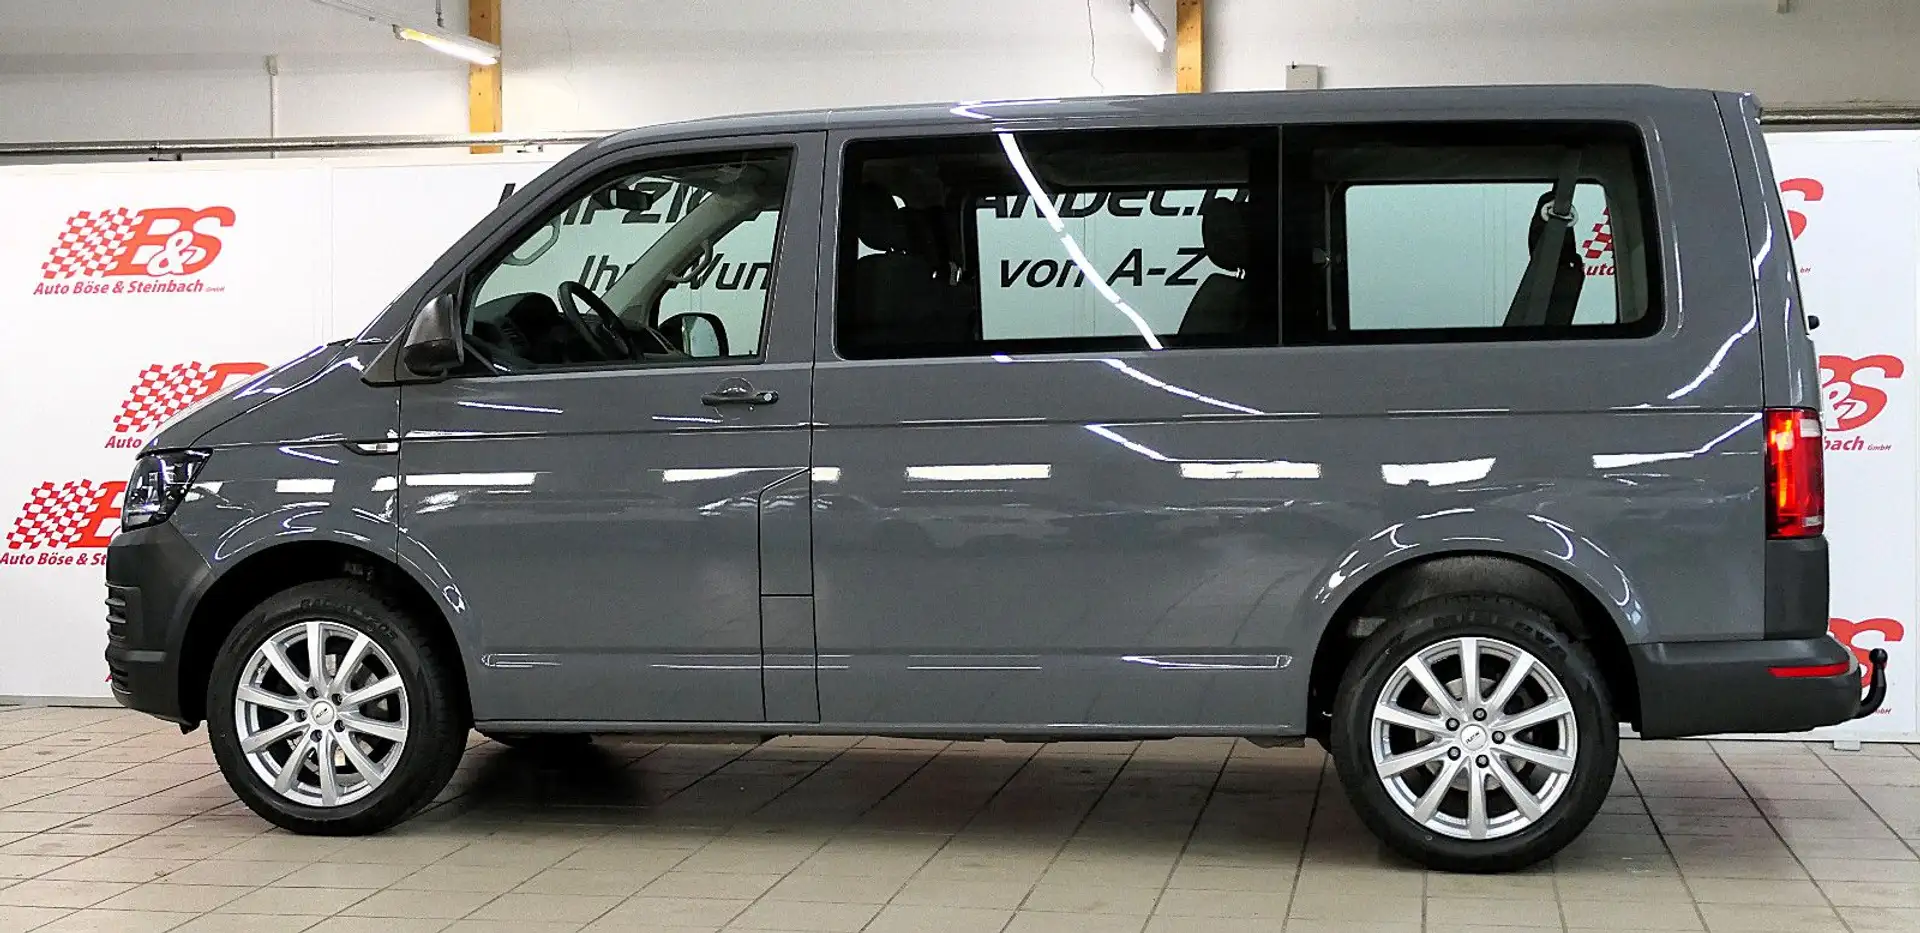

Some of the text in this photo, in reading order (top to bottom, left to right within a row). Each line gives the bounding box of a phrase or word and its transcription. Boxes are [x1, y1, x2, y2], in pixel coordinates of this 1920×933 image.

[579, 255, 634, 290] Ih
[1001, 259, 1088, 288] von
[1106, 248, 1208, 287] A-Z
[33, 282, 70, 295] Auto
[73, 281, 110, 294] Böse
[112, 280, 125, 294] &
[127, 279, 204, 293] Steinbach
[105, 435, 143, 448] Auto
[0, 552, 35, 565] Auto
[38, 552, 73, 565] Böse
[76, 552, 88, 565] &
